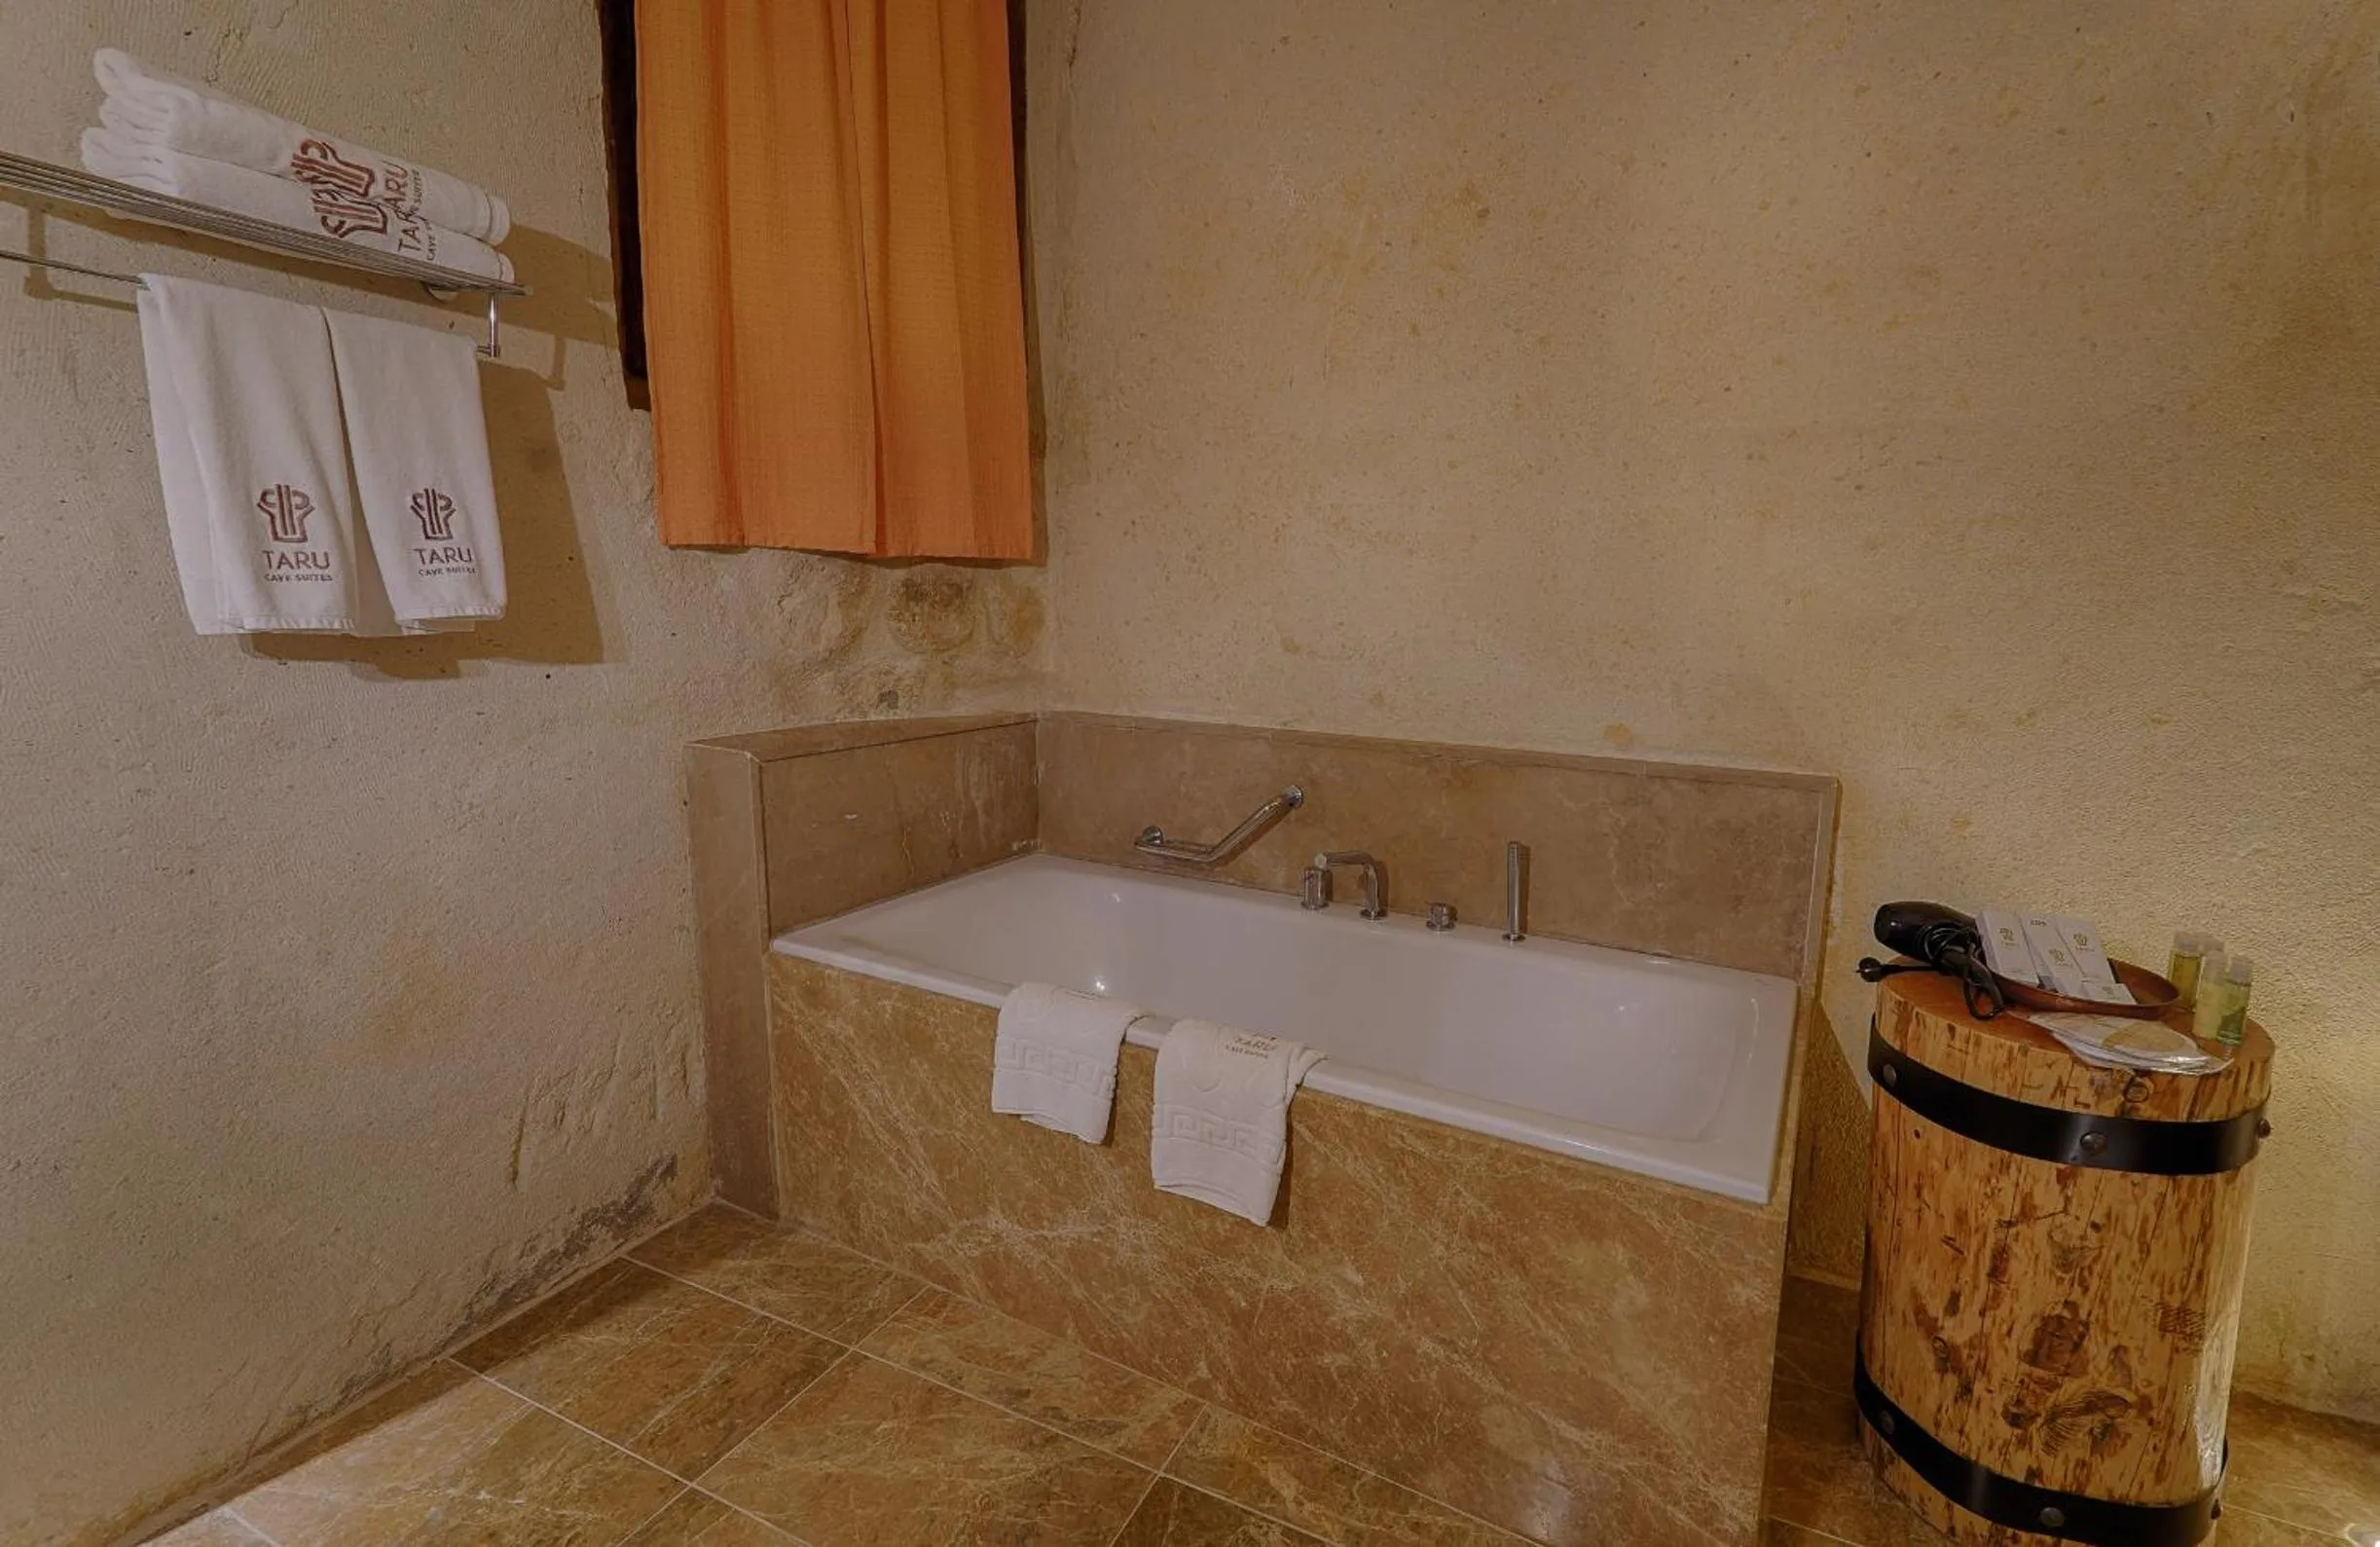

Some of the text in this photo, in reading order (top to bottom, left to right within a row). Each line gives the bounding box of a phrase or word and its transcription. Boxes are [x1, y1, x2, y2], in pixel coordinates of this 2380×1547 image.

[396, 211, 421, 252] TAR
[260, 549, 331, 571] TARU
[412, 546, 474, 566] TARU
